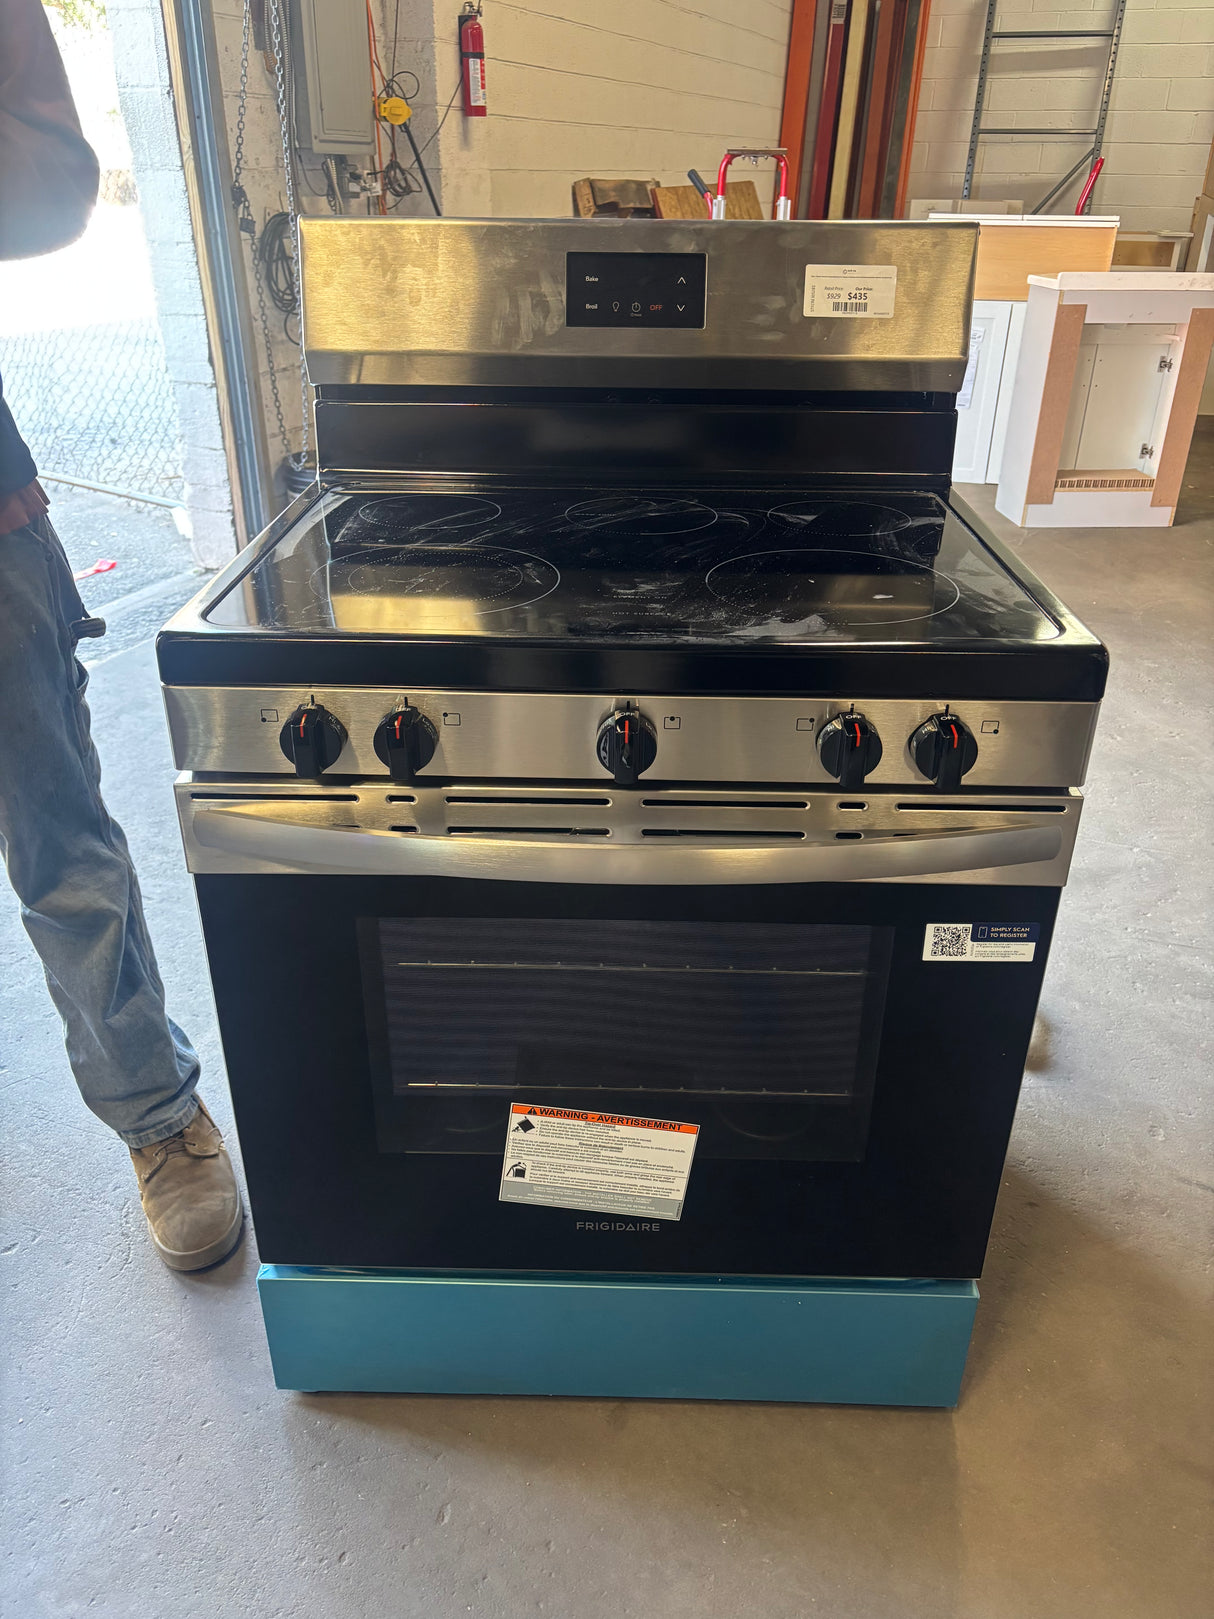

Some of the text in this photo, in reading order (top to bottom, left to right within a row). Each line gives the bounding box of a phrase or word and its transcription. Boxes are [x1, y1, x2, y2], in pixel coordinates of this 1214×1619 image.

[826, 292, 841, 300] $929
[847, 291, 868, 301] $435
[539, 1108, 589, 1121] WARNING
[596, 1114, 683, 1131] AVERTISSEMENT
[576, 1221, 661, 1232] FRIGIDAIRE
